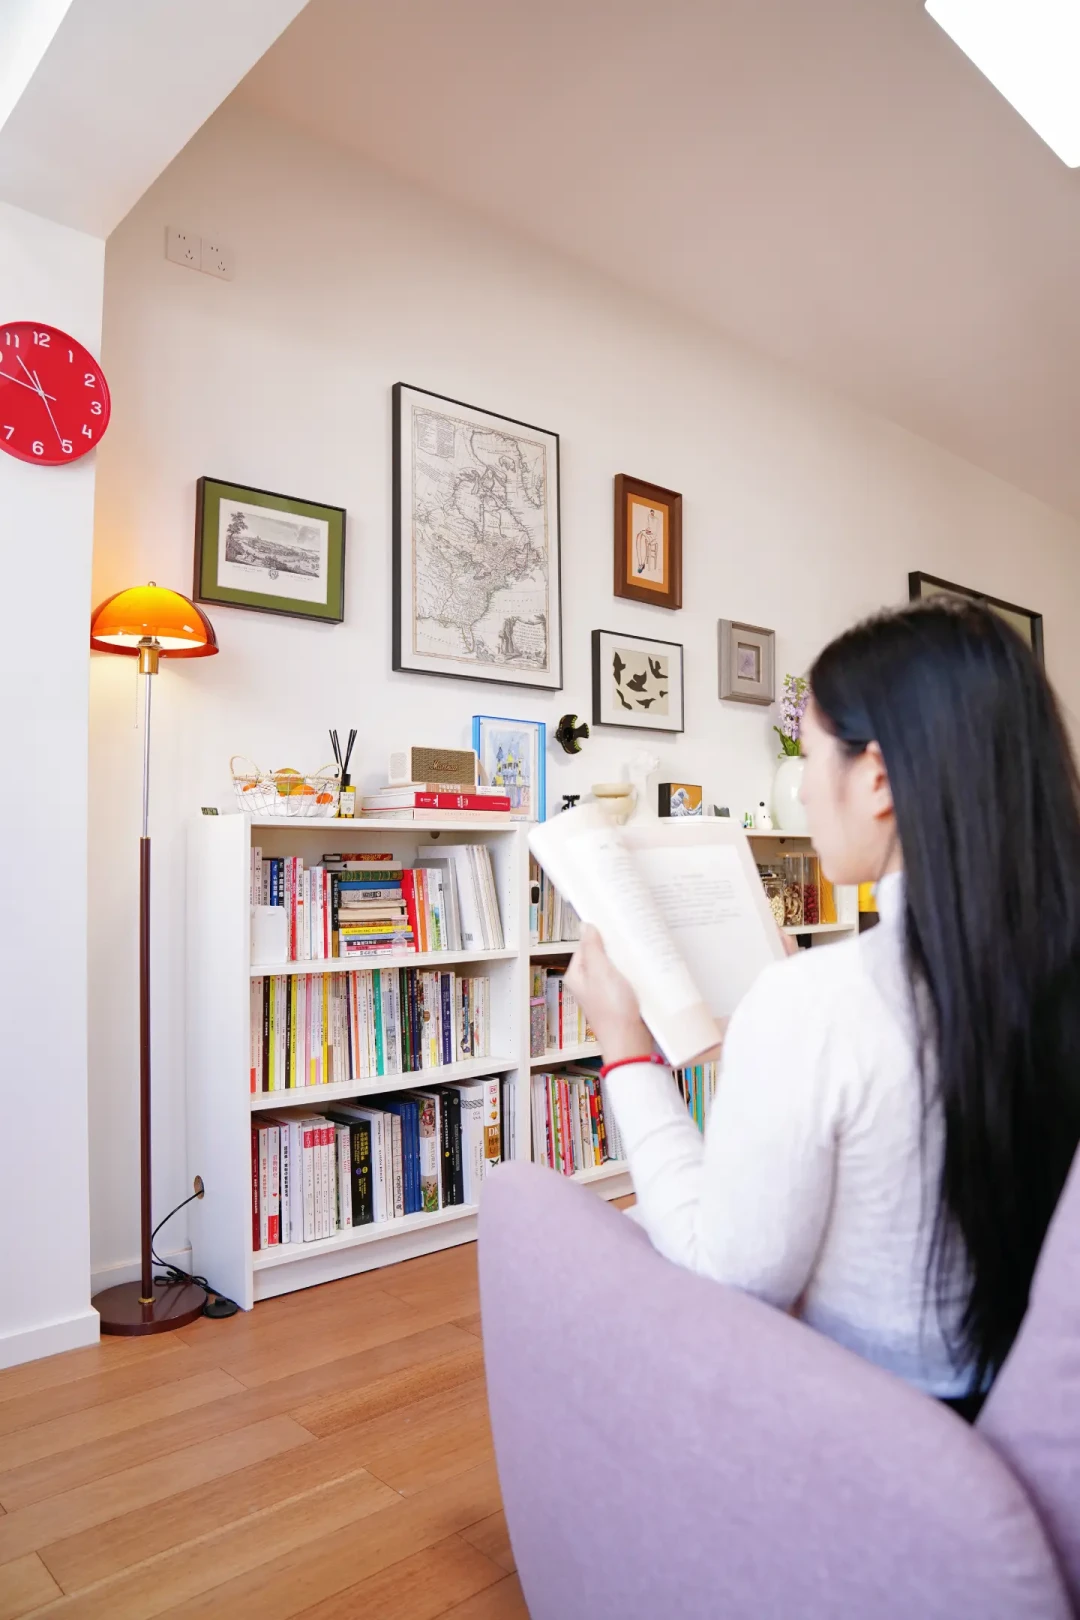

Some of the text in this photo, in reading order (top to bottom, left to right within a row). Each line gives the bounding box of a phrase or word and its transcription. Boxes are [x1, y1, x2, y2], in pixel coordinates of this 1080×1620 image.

[5, 332, 19, 348] 11
[33, 331, 50, 347] 12
[68, 350, 73, 363] 1
[84, 373, 95, 388] 2
[90, 401, 102, 415] 3
[4, 425, 15, 440] 7
[81, 424, 92, 439] 4
[32, 441, 44, 455] 6
[61, 439, 73, 454] 5
